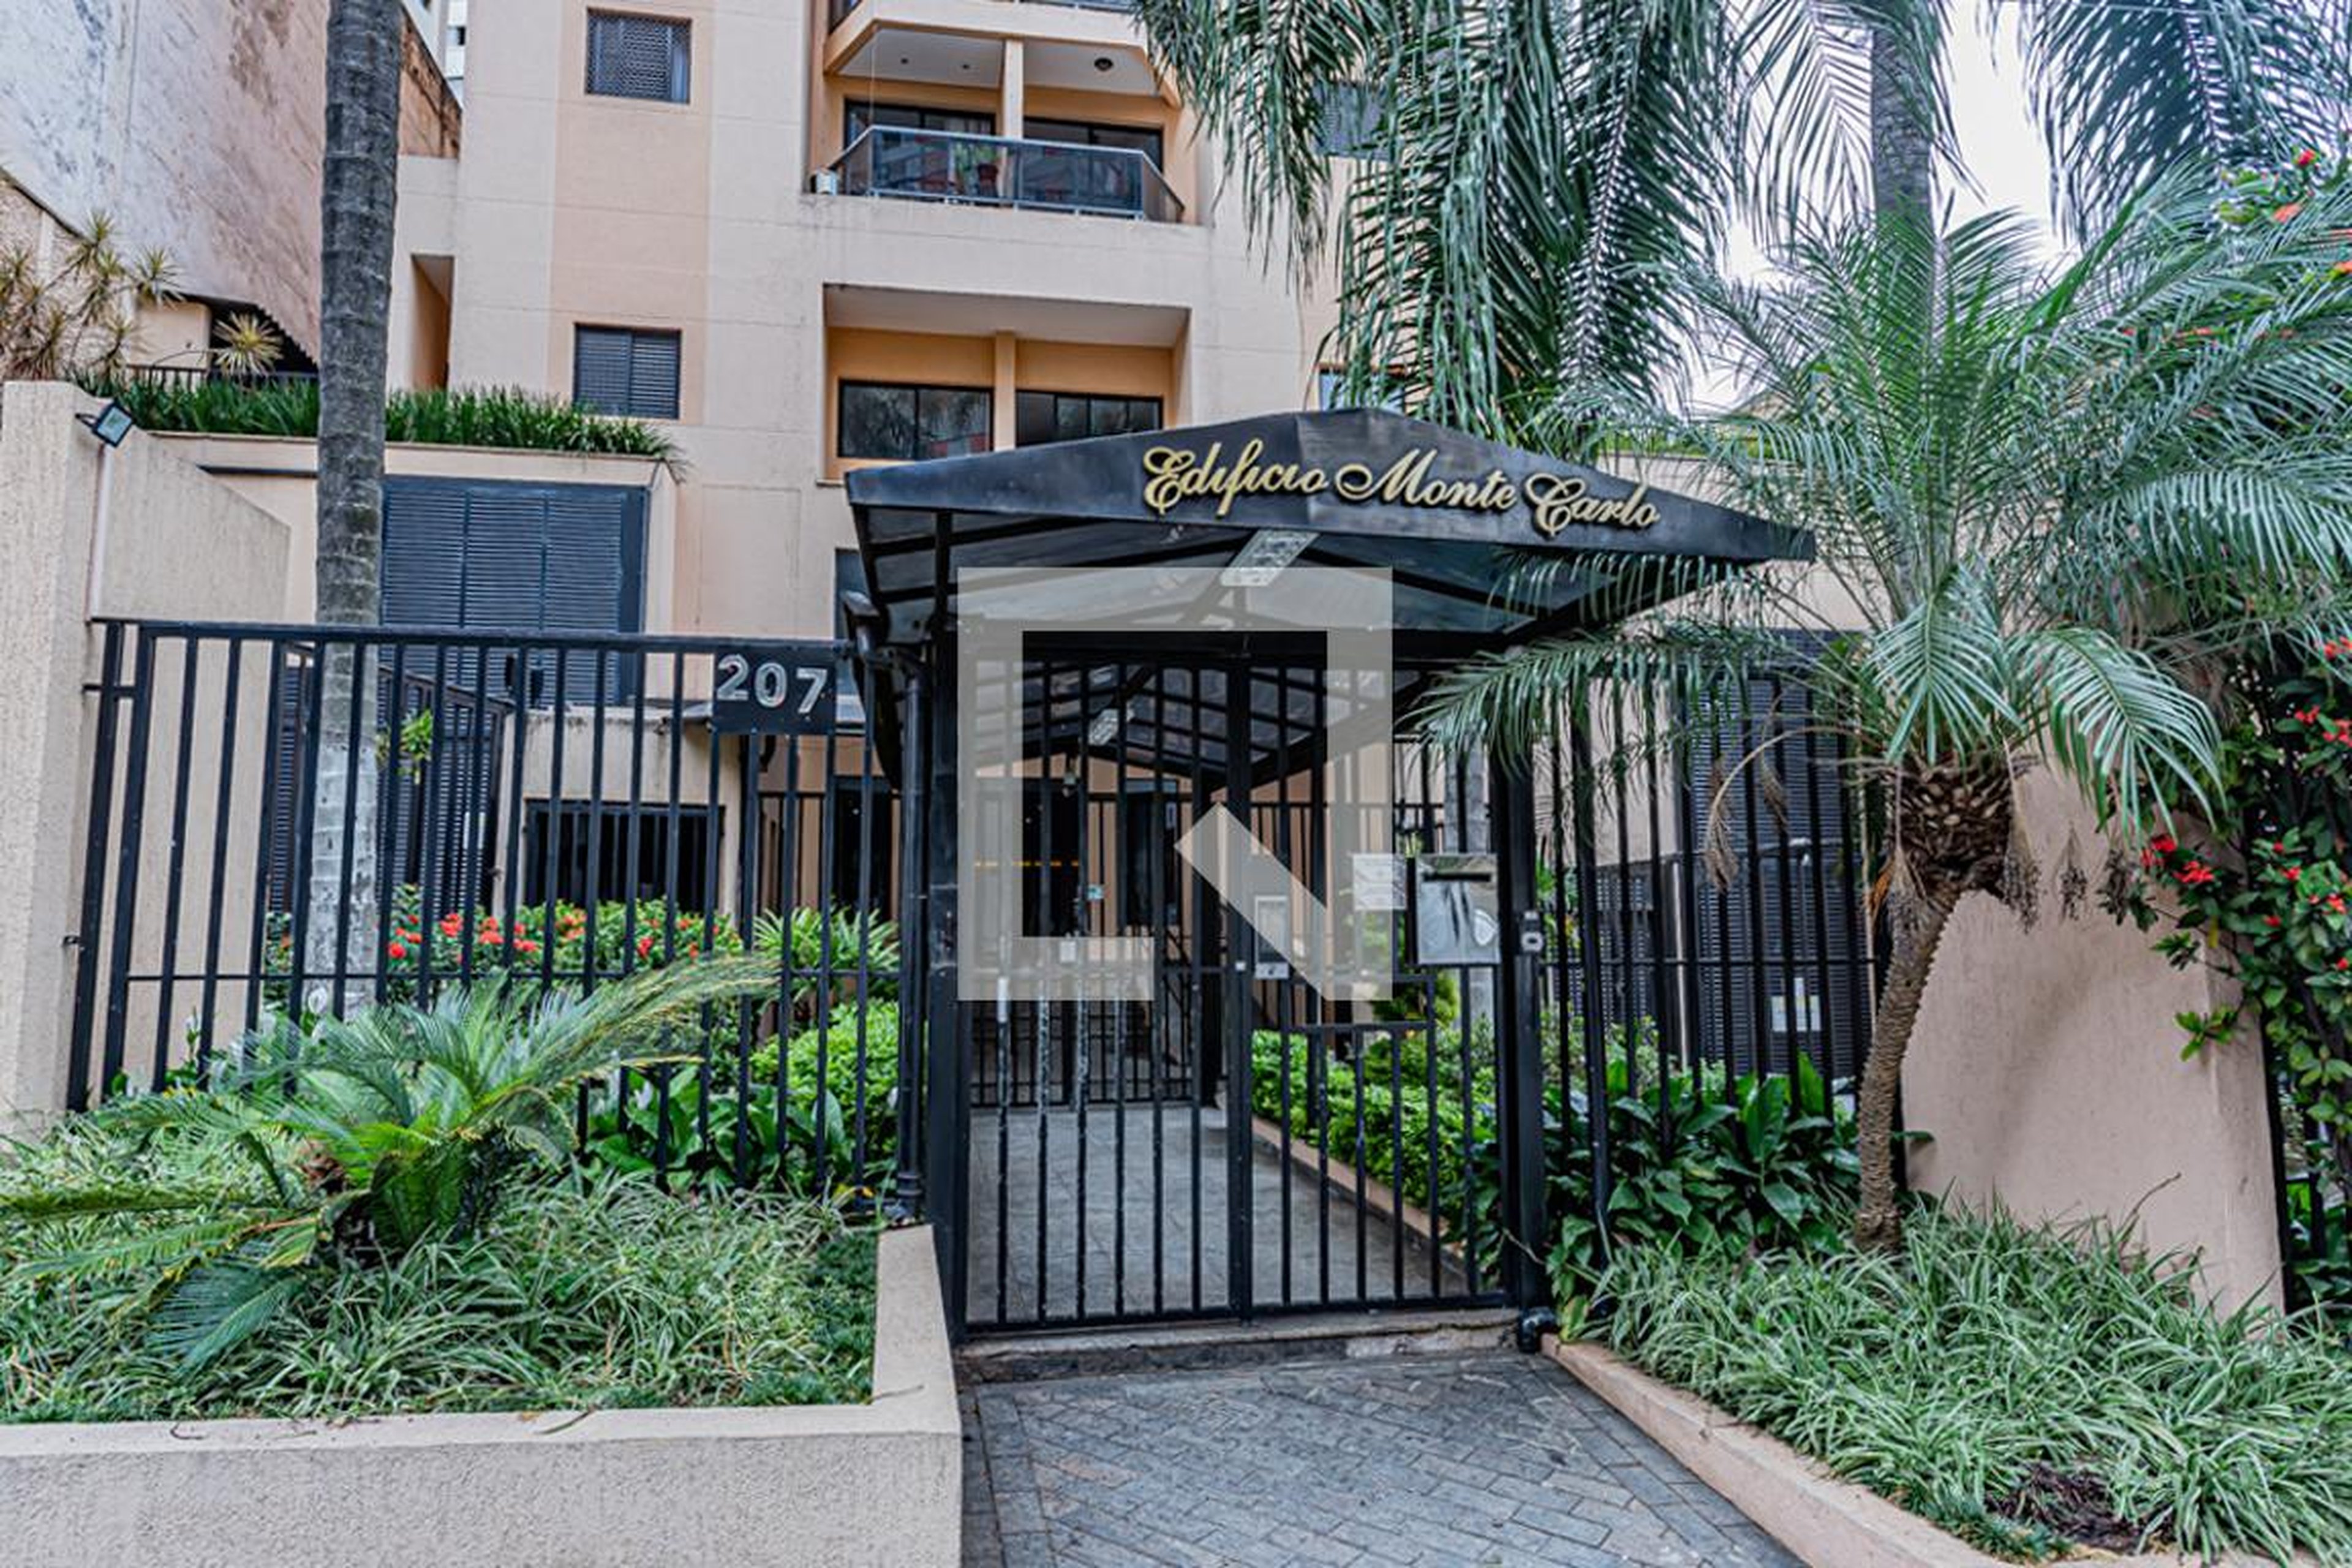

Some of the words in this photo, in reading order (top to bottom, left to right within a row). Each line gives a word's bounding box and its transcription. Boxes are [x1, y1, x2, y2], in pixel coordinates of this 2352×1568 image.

[1335, 448, 1518, 509] Monte
[1525, 472, 1660, 537] Carlo
[717, 654, 827, 714] 207
